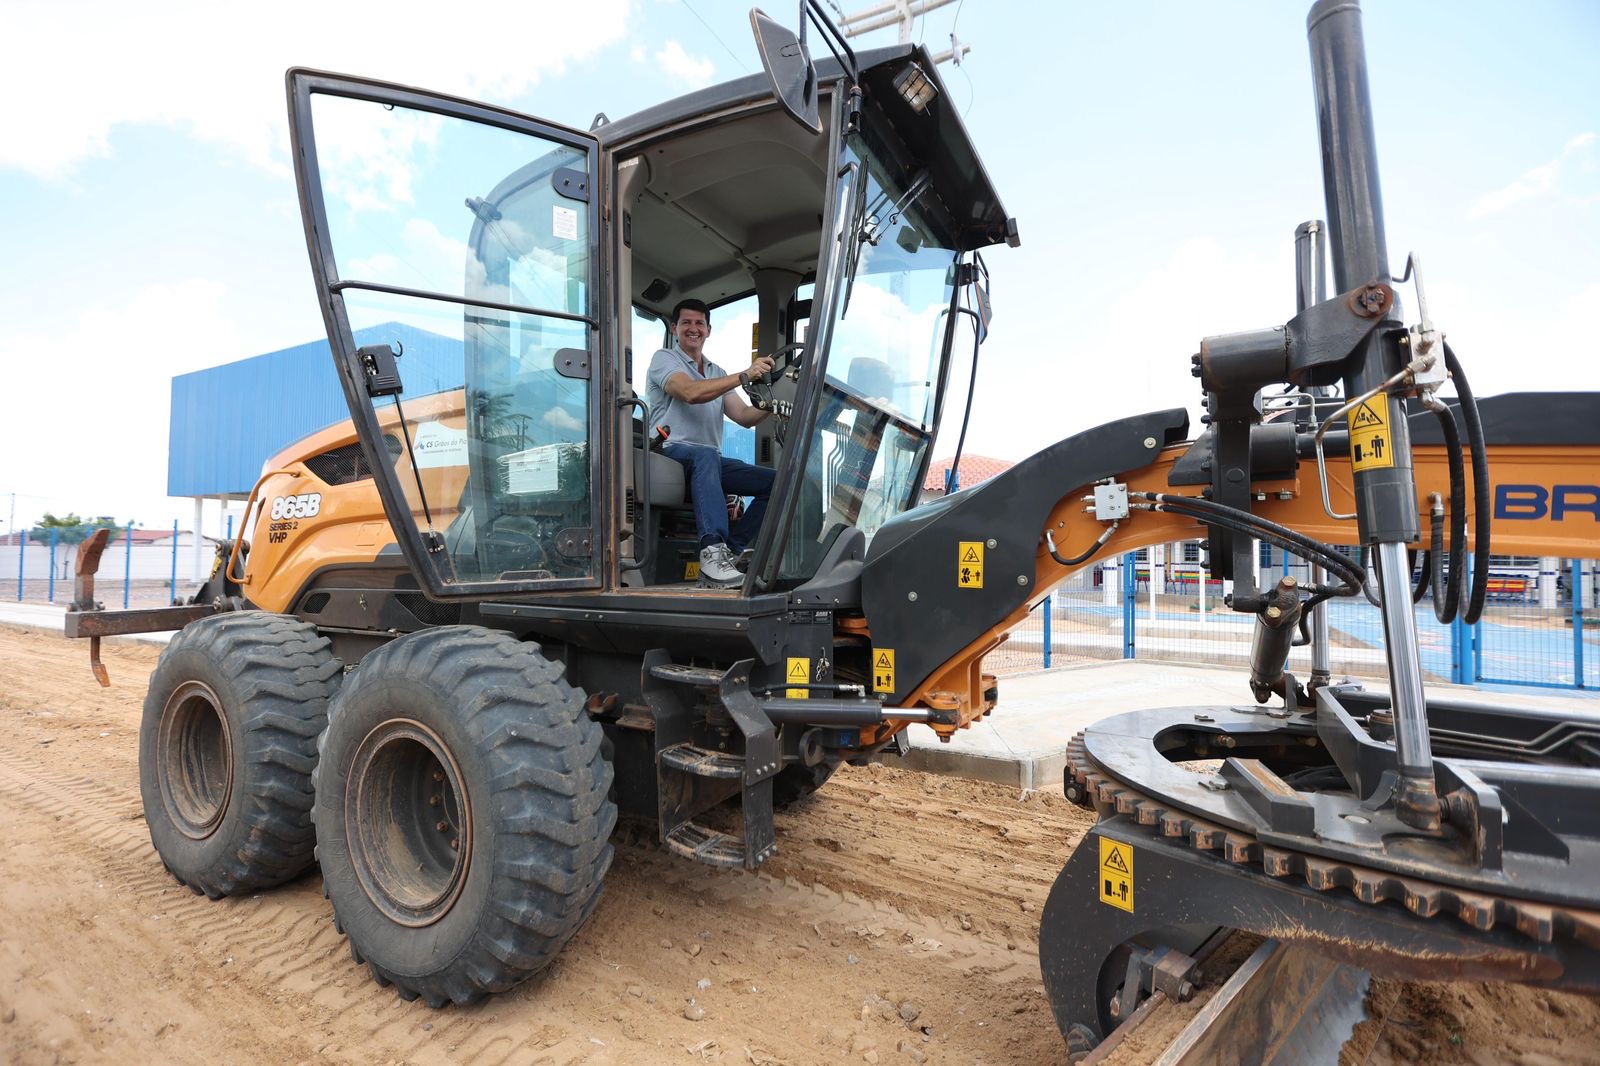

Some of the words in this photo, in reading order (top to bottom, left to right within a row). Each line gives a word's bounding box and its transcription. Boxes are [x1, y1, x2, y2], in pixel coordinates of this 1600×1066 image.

[271, 493, 321, 521] 865B
[1493, 484, 1600, 522] BR
[269, 521, 293, 531] SERIES
[293, 521, 299, 530] 2
[269, 532, 288, 544] VHP
